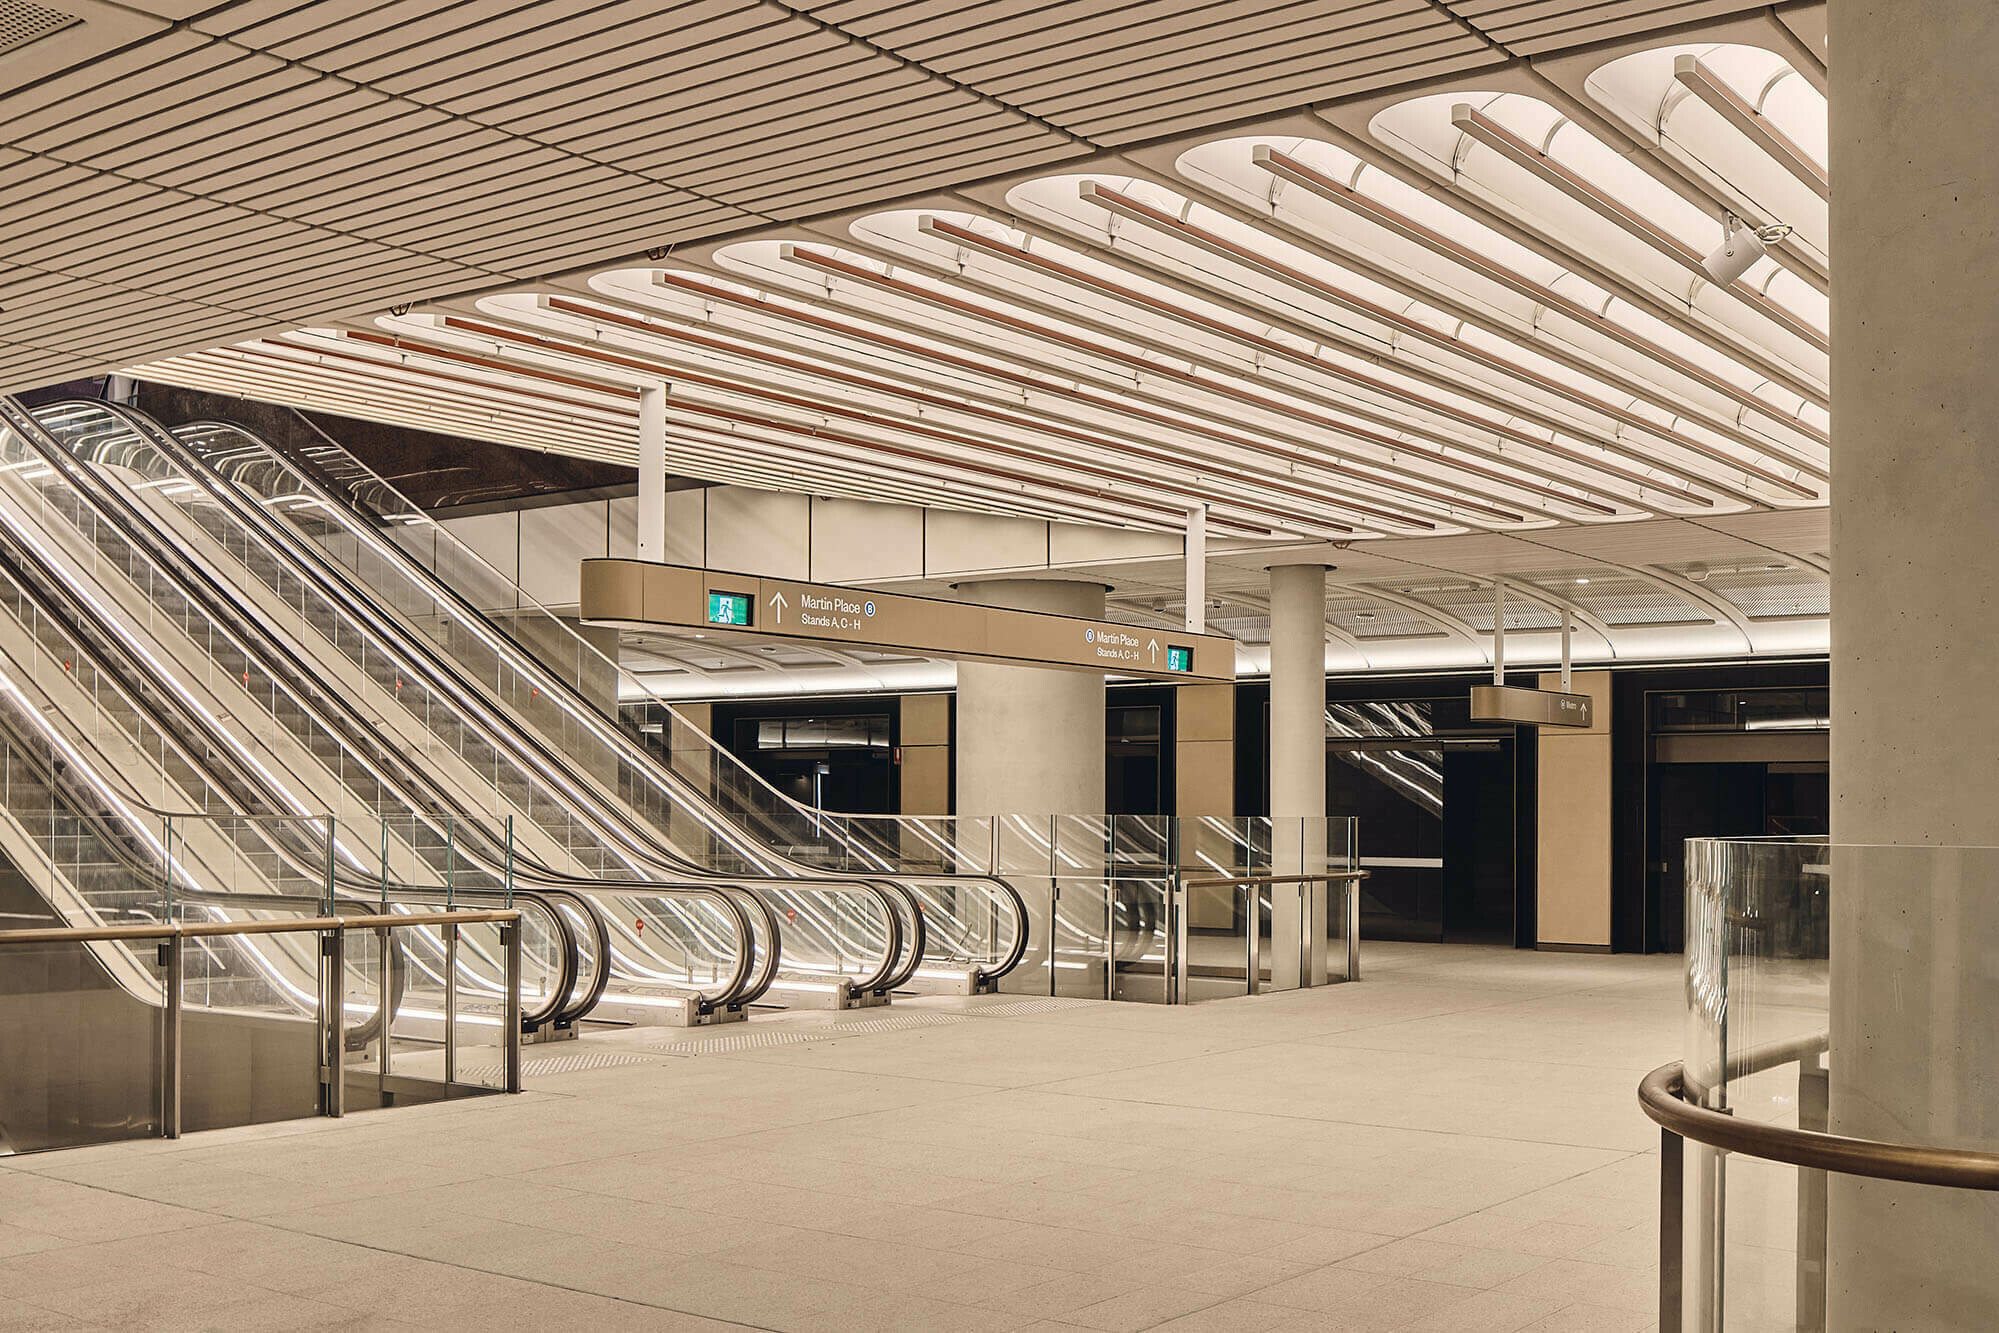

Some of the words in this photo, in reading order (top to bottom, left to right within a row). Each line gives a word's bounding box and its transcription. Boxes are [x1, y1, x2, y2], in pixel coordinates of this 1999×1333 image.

[801, 594, 832, 611] Martin
[834, 599, 860, 614] Place
[801, 613, 830, 627] Stands
[1096, 631, 1119, 645] Martin
[1119, 633, 1139, 647] Place
[1097, 647, 1117, 658] Stands
